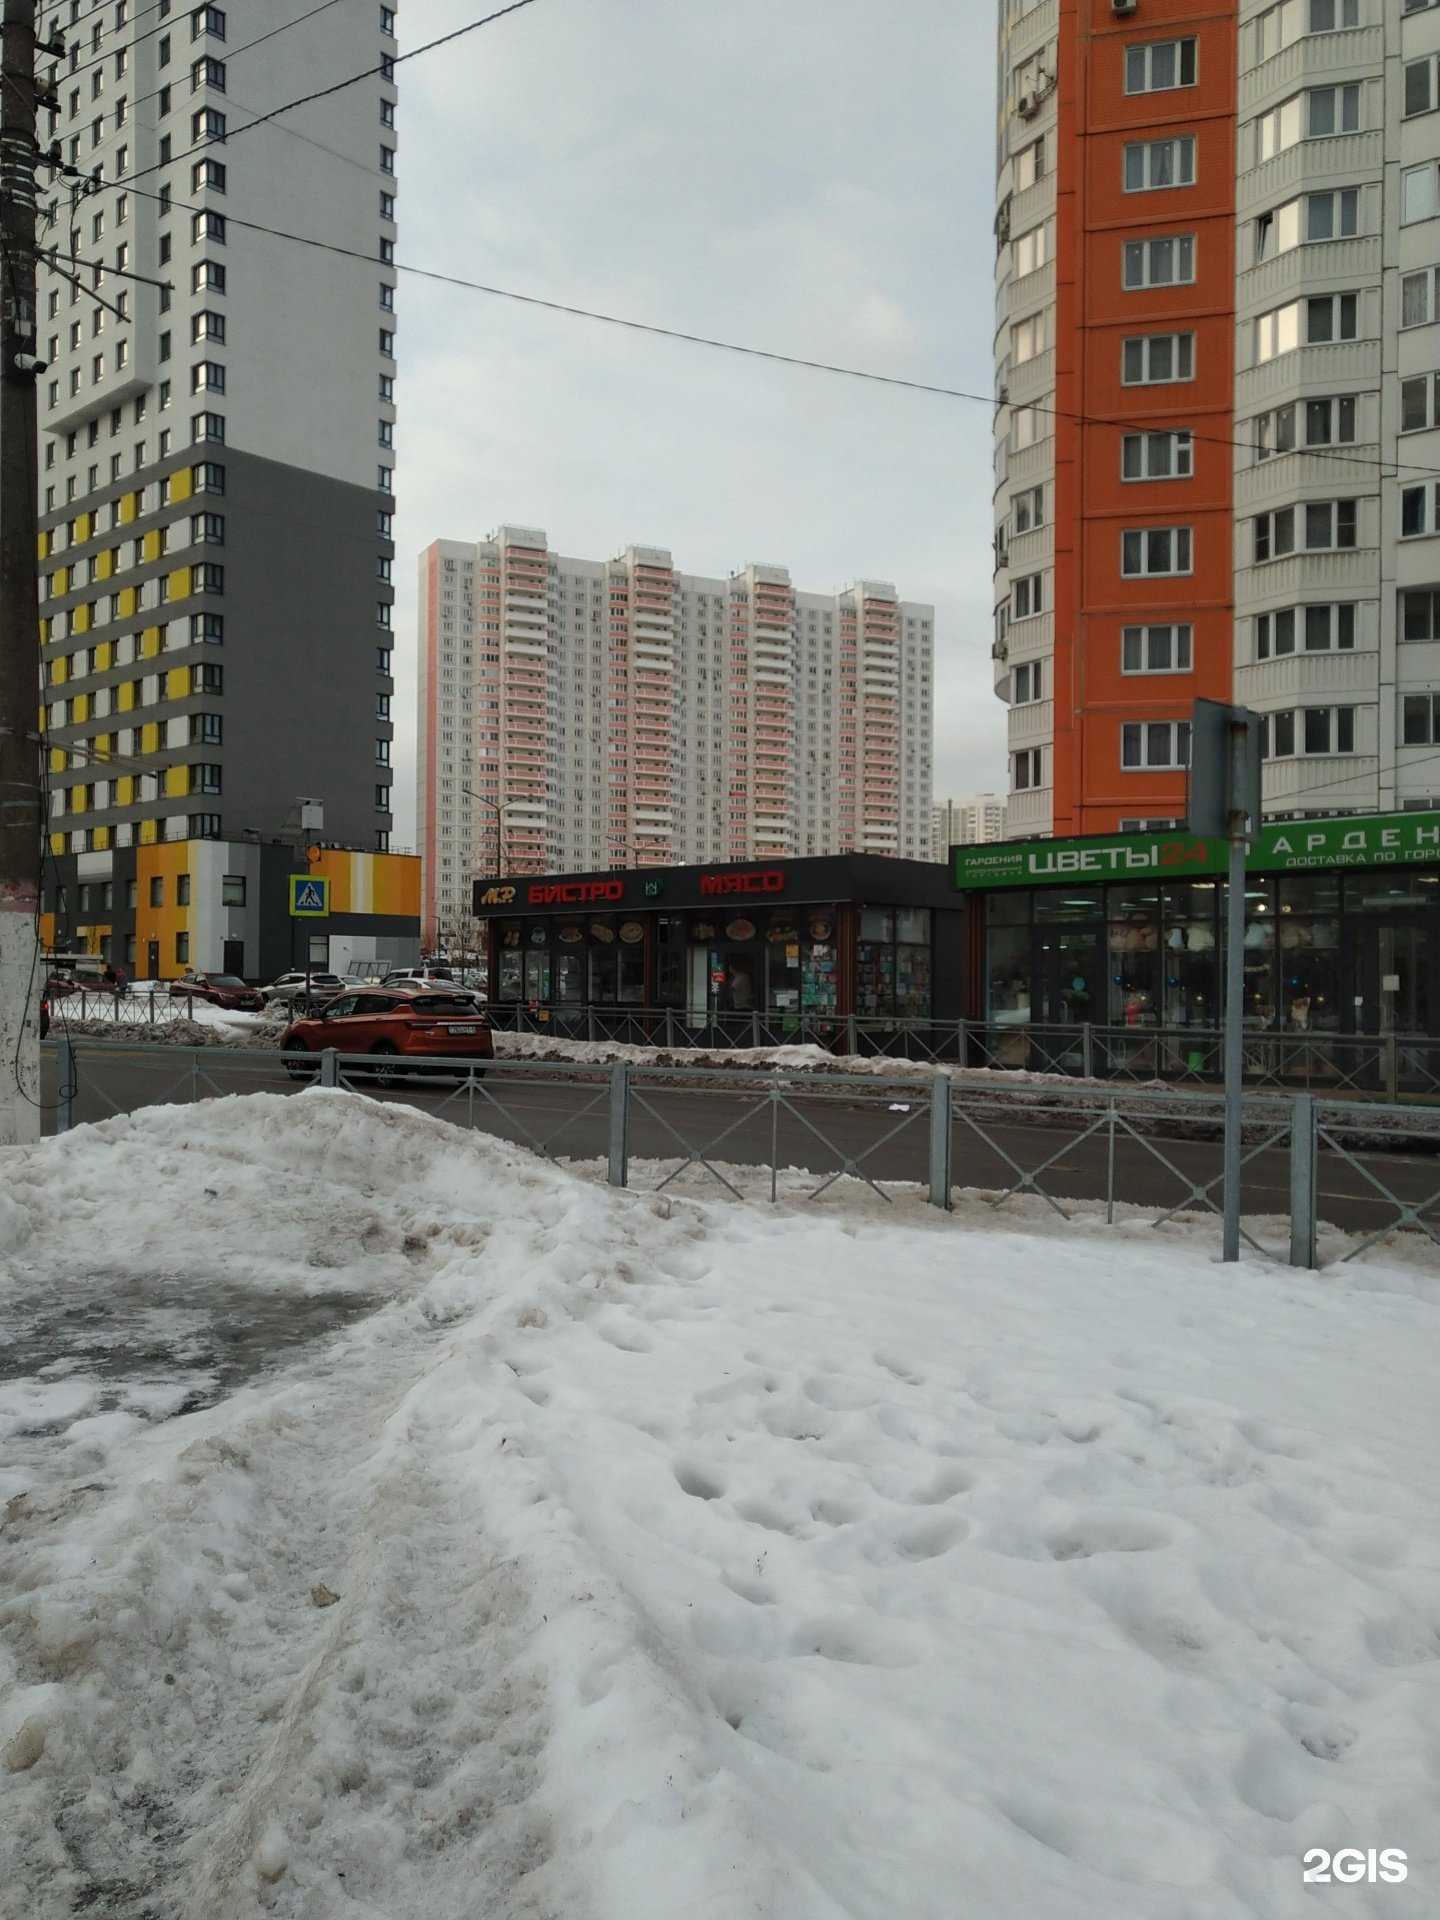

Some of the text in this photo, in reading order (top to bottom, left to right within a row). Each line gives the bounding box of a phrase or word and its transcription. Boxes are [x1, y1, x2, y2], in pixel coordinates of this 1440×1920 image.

[1286, 854, 1367, 867] ДОСТАВКА
[1374, 852, 1396, 862] ПО
[528, 880, 624, 904] БИСТРО
[700, 871, 784, 893] МЯСО
